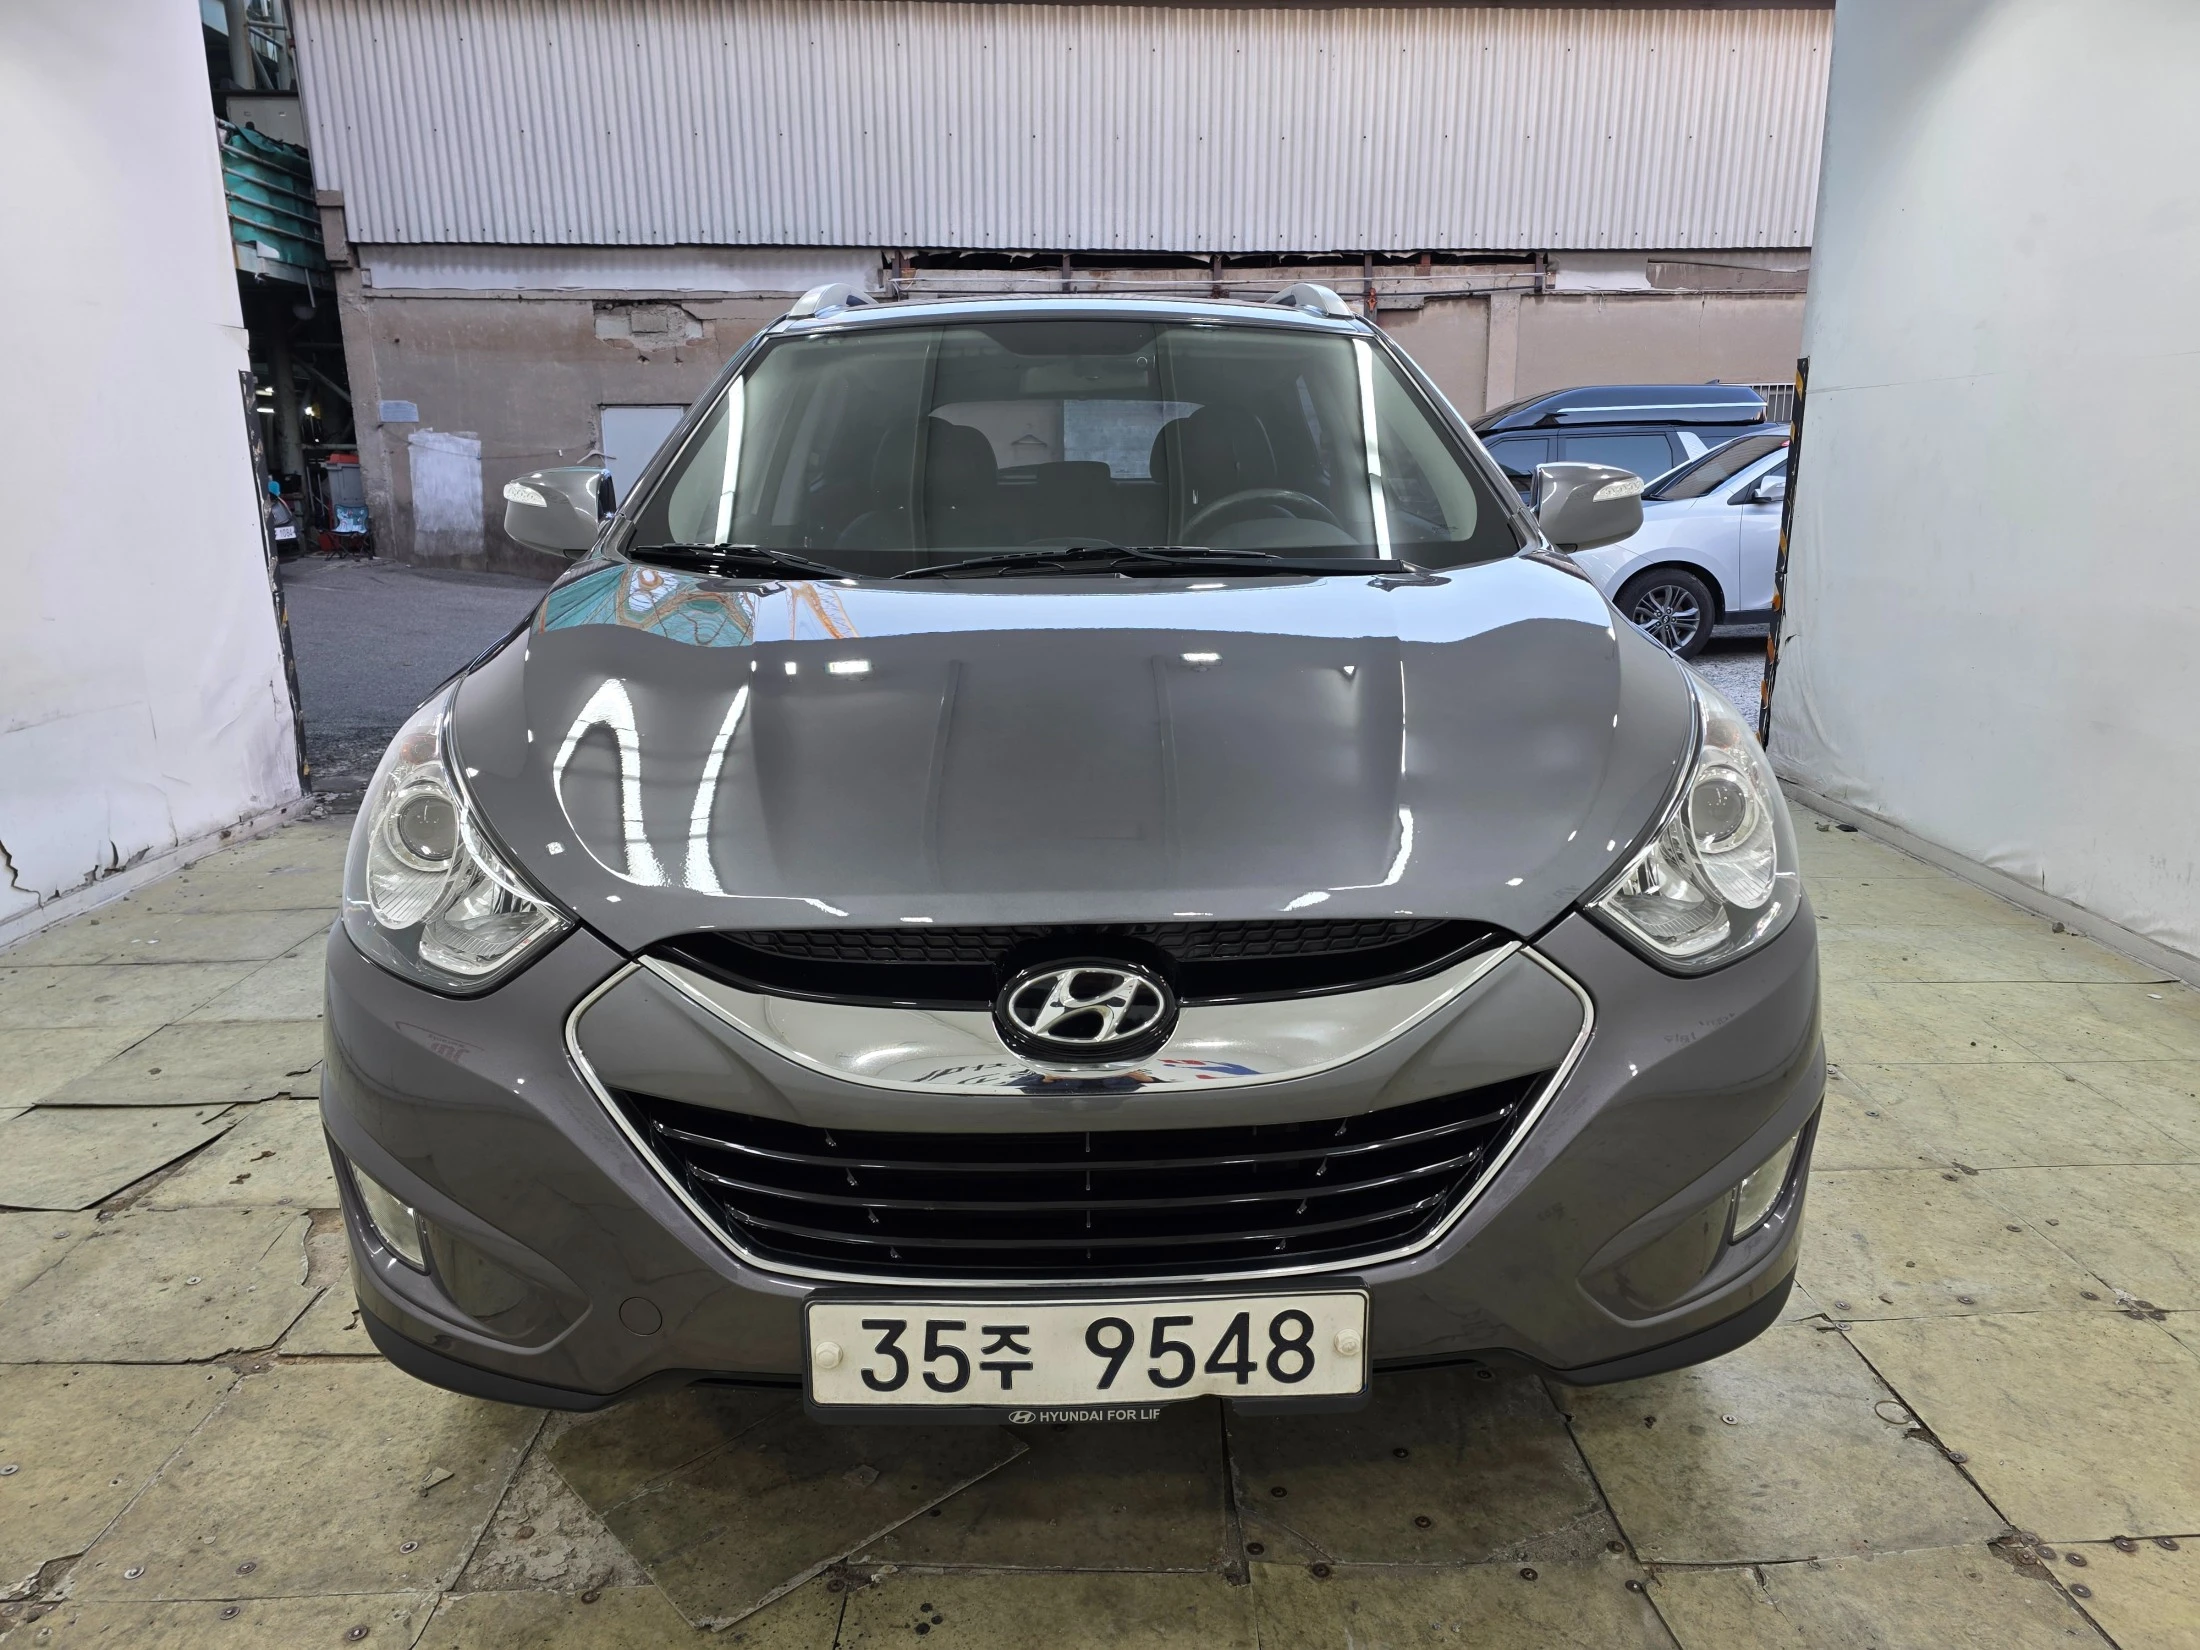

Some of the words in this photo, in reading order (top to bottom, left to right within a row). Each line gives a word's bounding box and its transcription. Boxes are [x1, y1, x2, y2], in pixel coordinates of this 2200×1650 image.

[860, 1318, 1034, 1393] 35주
[1084, 1309, 1315, 1390] 9548
[1039, 1410, 1103, 1422] HYUNDAI
[1107, 1409, 1137, 1421] FOR
